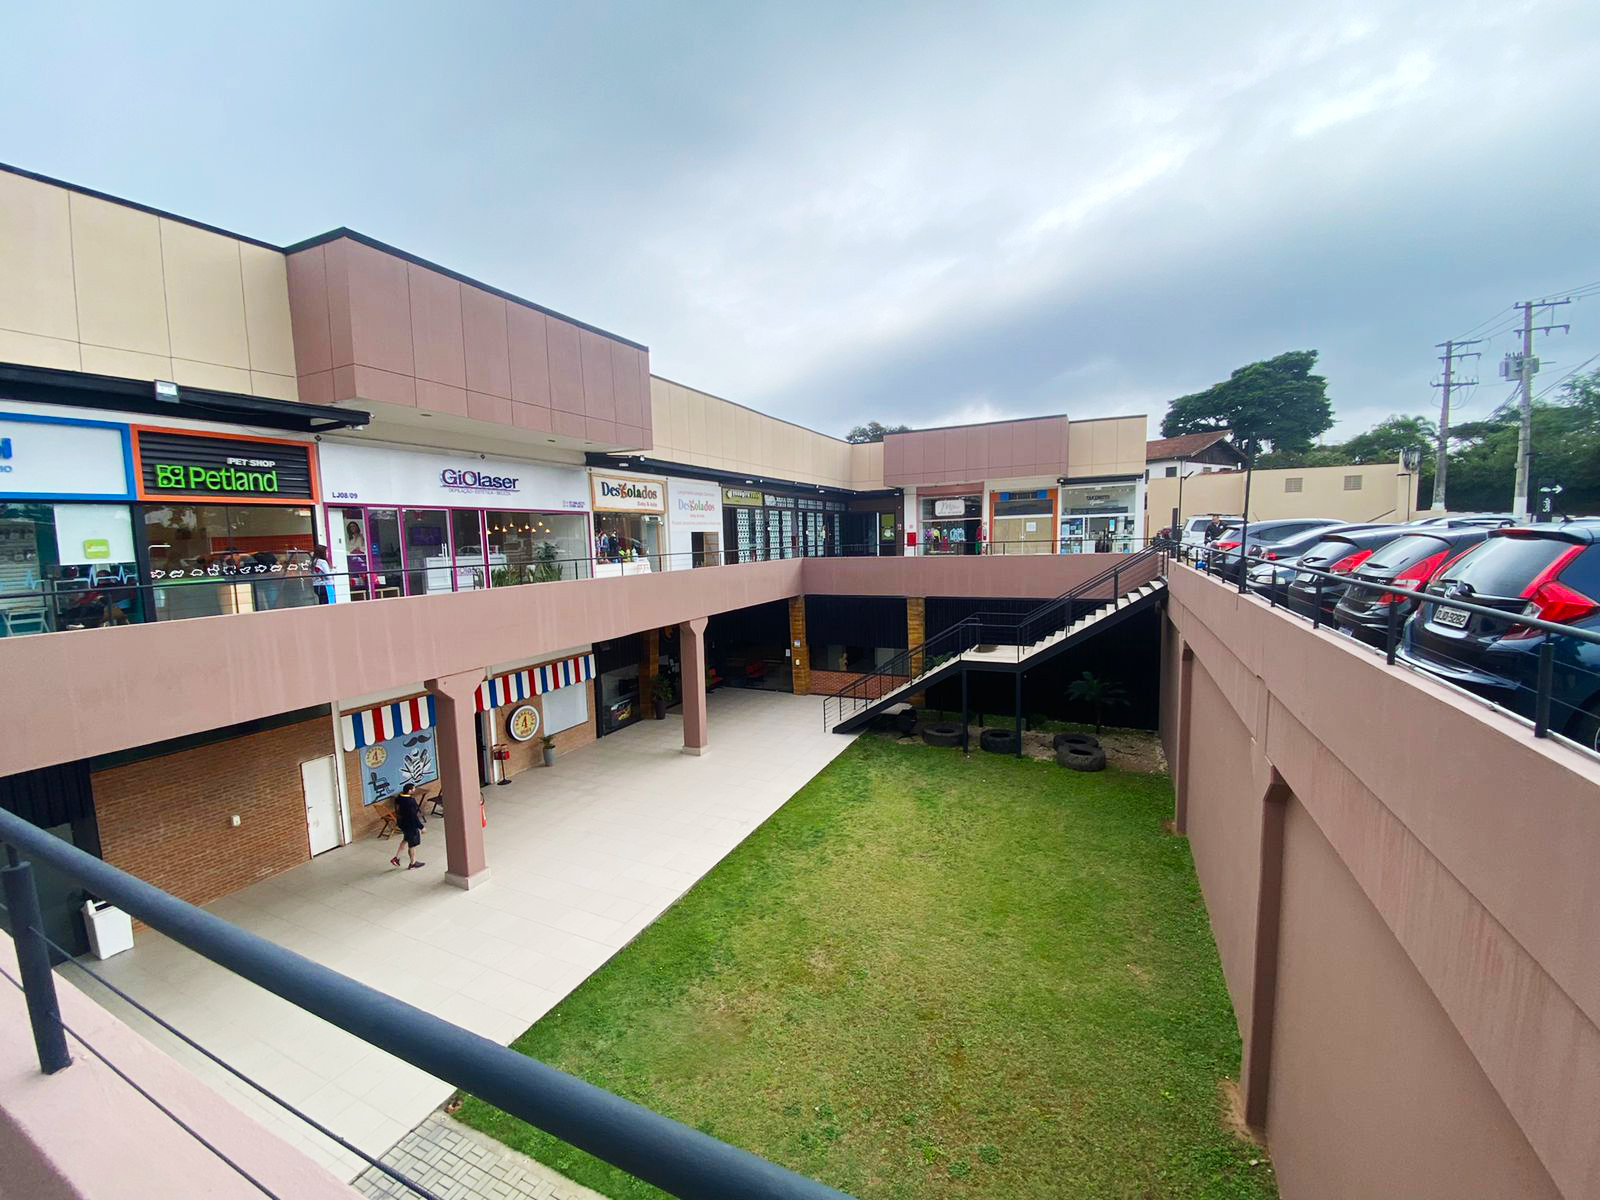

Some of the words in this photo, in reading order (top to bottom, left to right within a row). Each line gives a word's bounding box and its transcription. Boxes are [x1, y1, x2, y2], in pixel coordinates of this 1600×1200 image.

[227, 457, 248, 466] PET
[249, 459, 276, 468] SHOP
[188, 466, 279, 492] Petland
